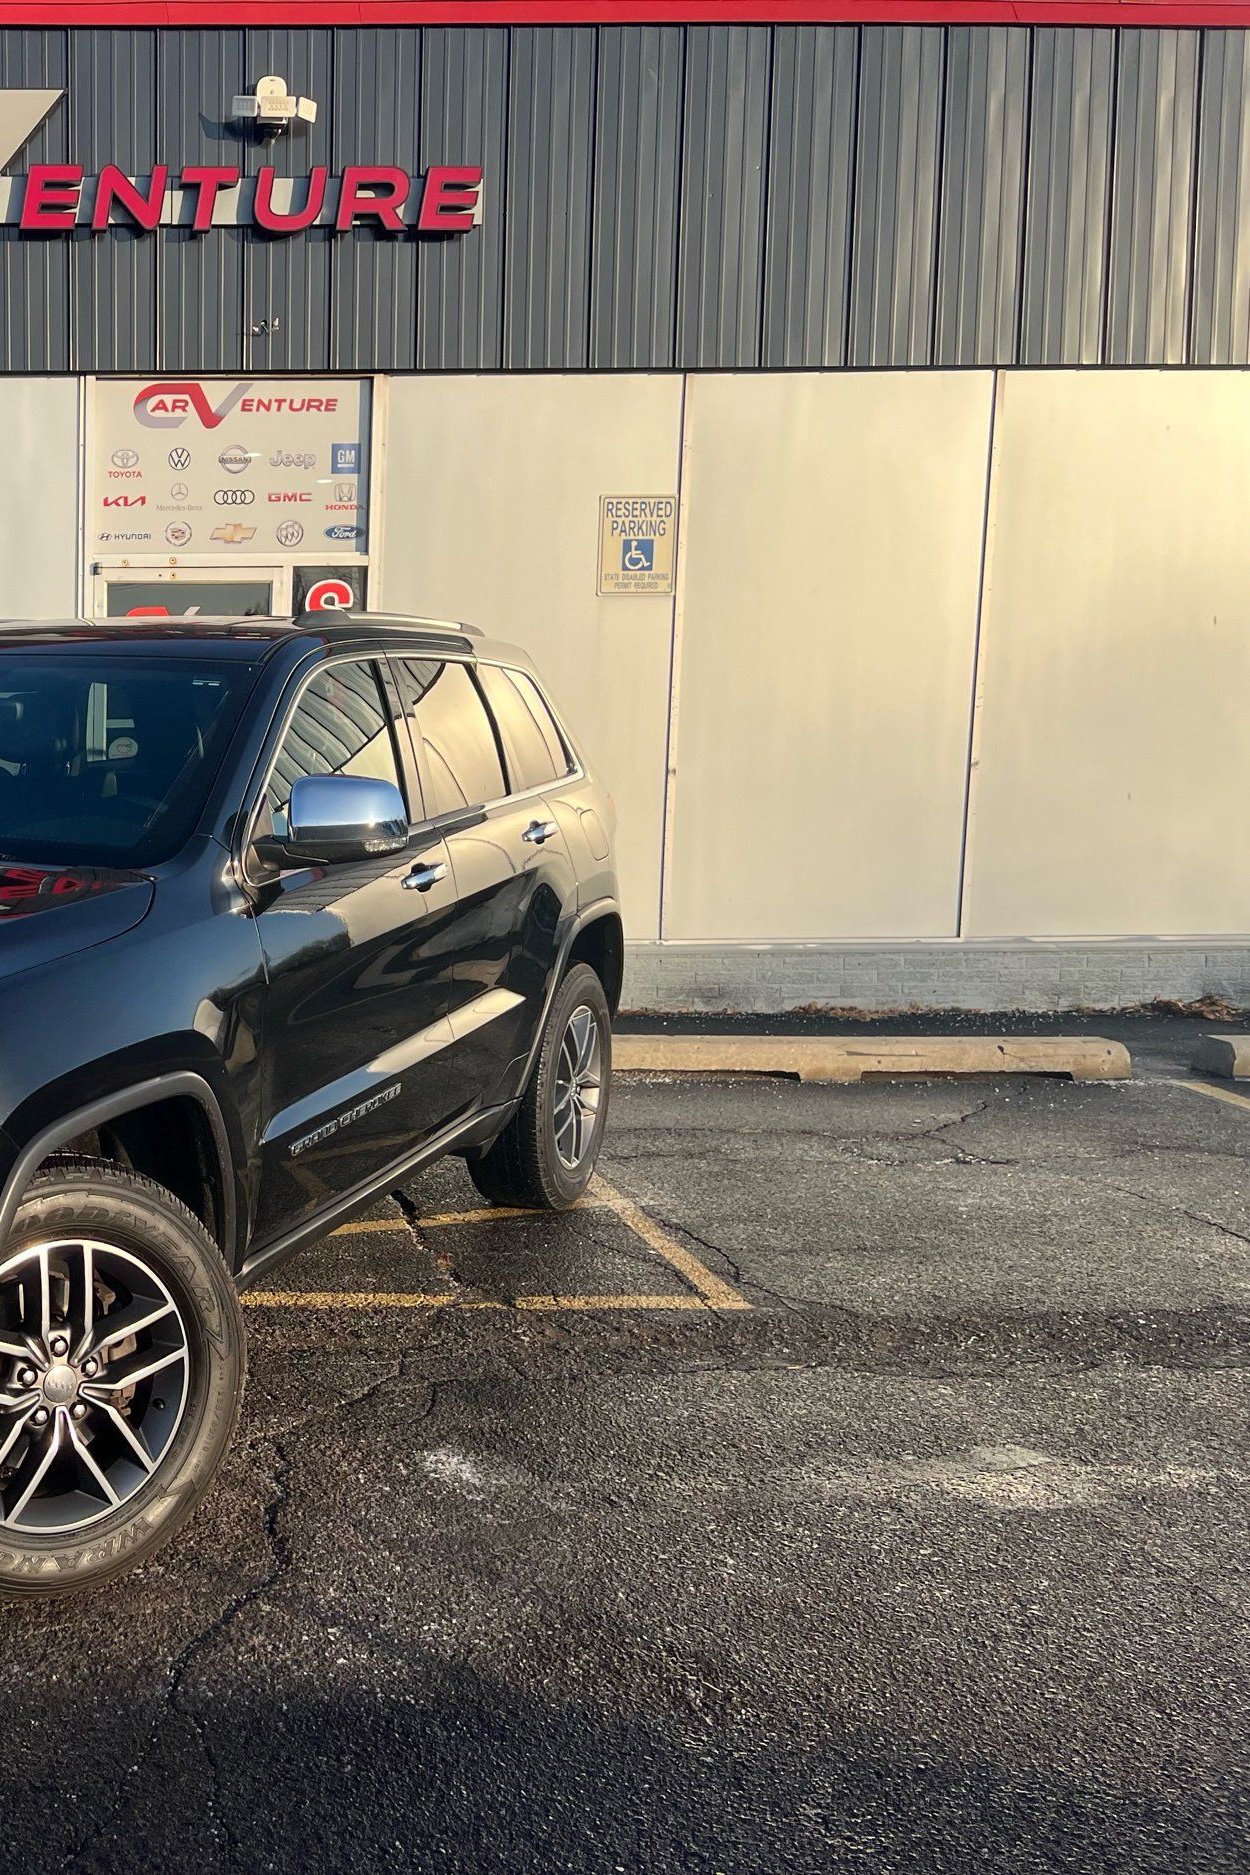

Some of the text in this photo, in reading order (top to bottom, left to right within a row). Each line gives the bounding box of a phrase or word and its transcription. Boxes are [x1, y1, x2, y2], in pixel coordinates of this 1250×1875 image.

[269, 450, 317, 469] Jeep
[337, 449, 355, 463] GM
[107, 470, 143, 479] TOYOTA
[102, 495, 146, 507] KIA
[267, 492, 313, 502] GMC
[606, 501, 673, 518] RESERVED
[331, 526, 357, 539] Ford
[611, 519, 666, 537] PARKING
[114, 533, 152, 541] HYUNDAI
[604, 573, 670, 581] STATE DISABLED PARKING
[9, 1205, 216, 1314] OODYEAR
